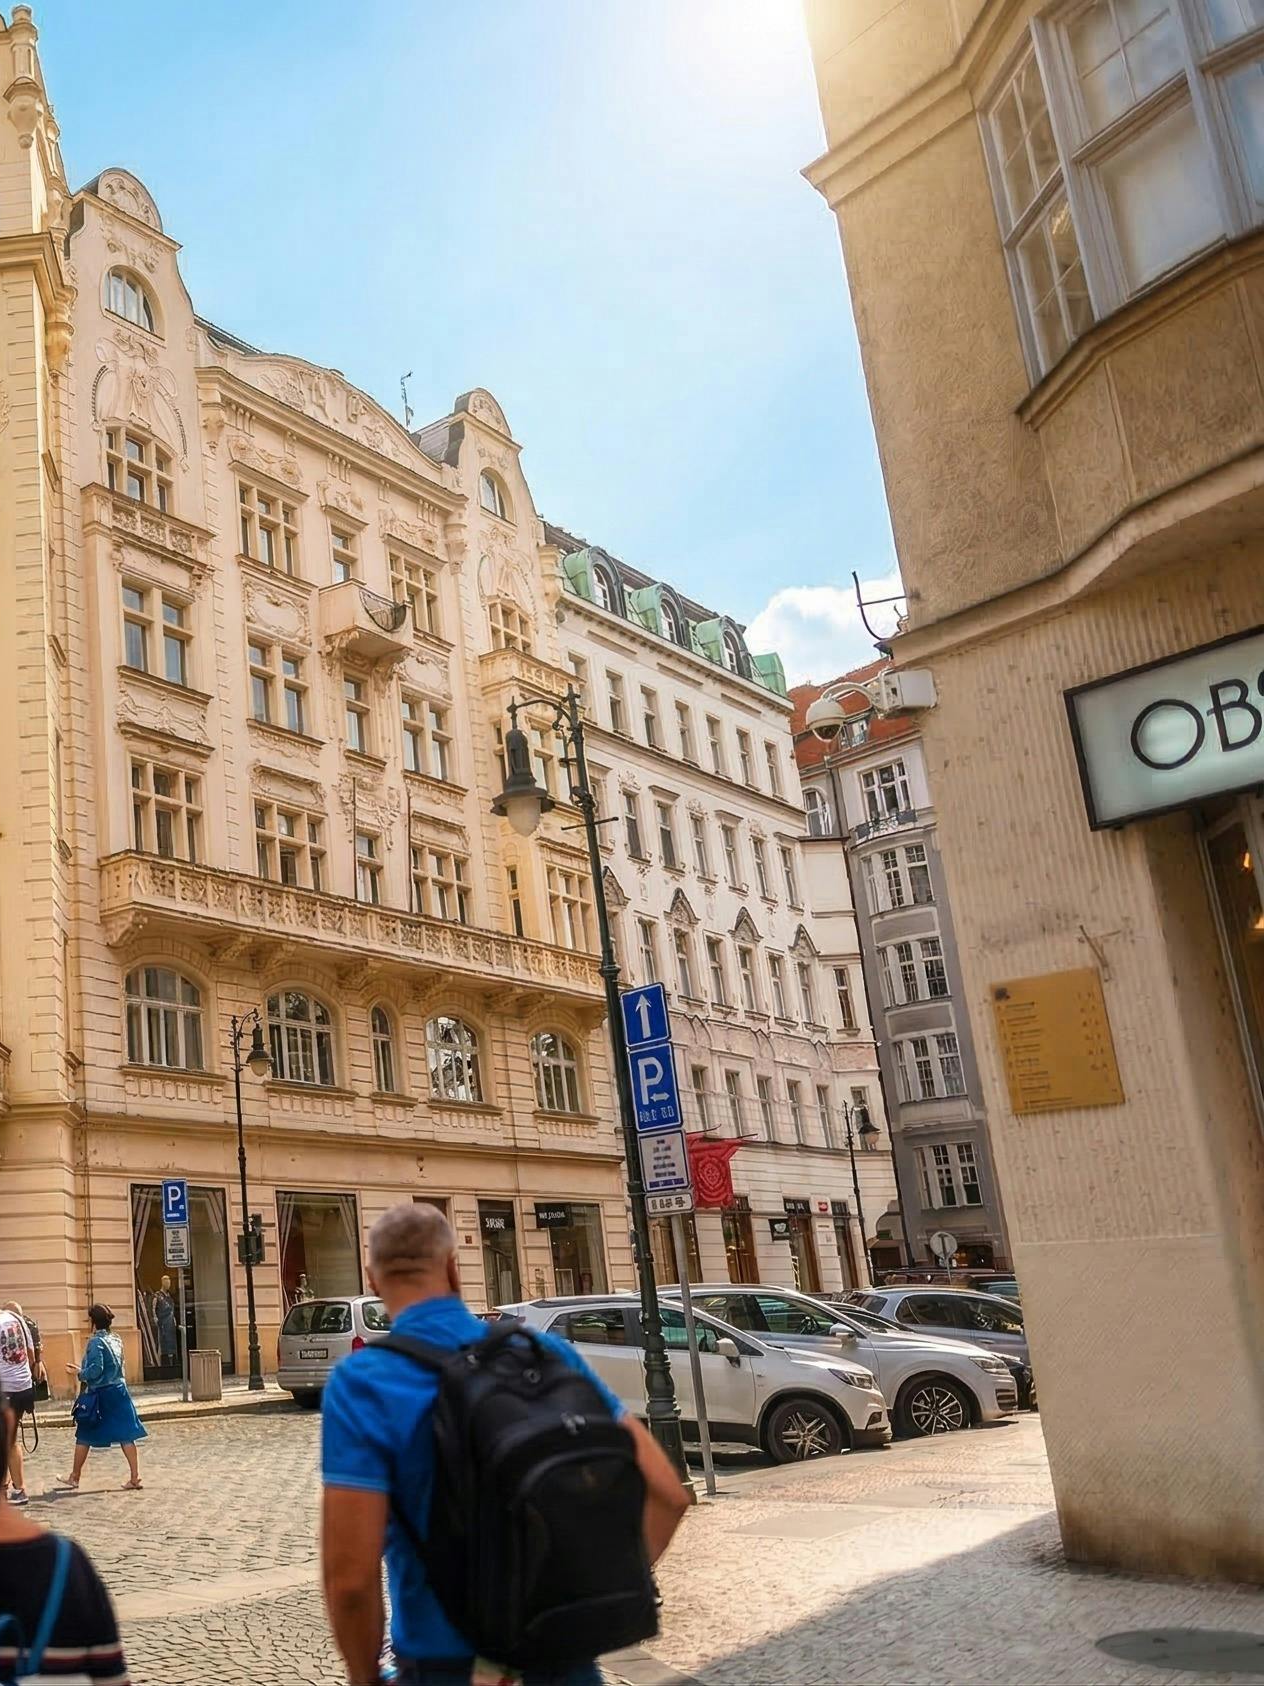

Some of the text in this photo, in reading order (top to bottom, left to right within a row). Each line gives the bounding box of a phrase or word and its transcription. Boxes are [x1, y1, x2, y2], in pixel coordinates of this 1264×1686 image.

[1131, 669, 1264, 770] OB
[638, 1057, 664, 1105] P
[168, 1186, 181, 1211] P
